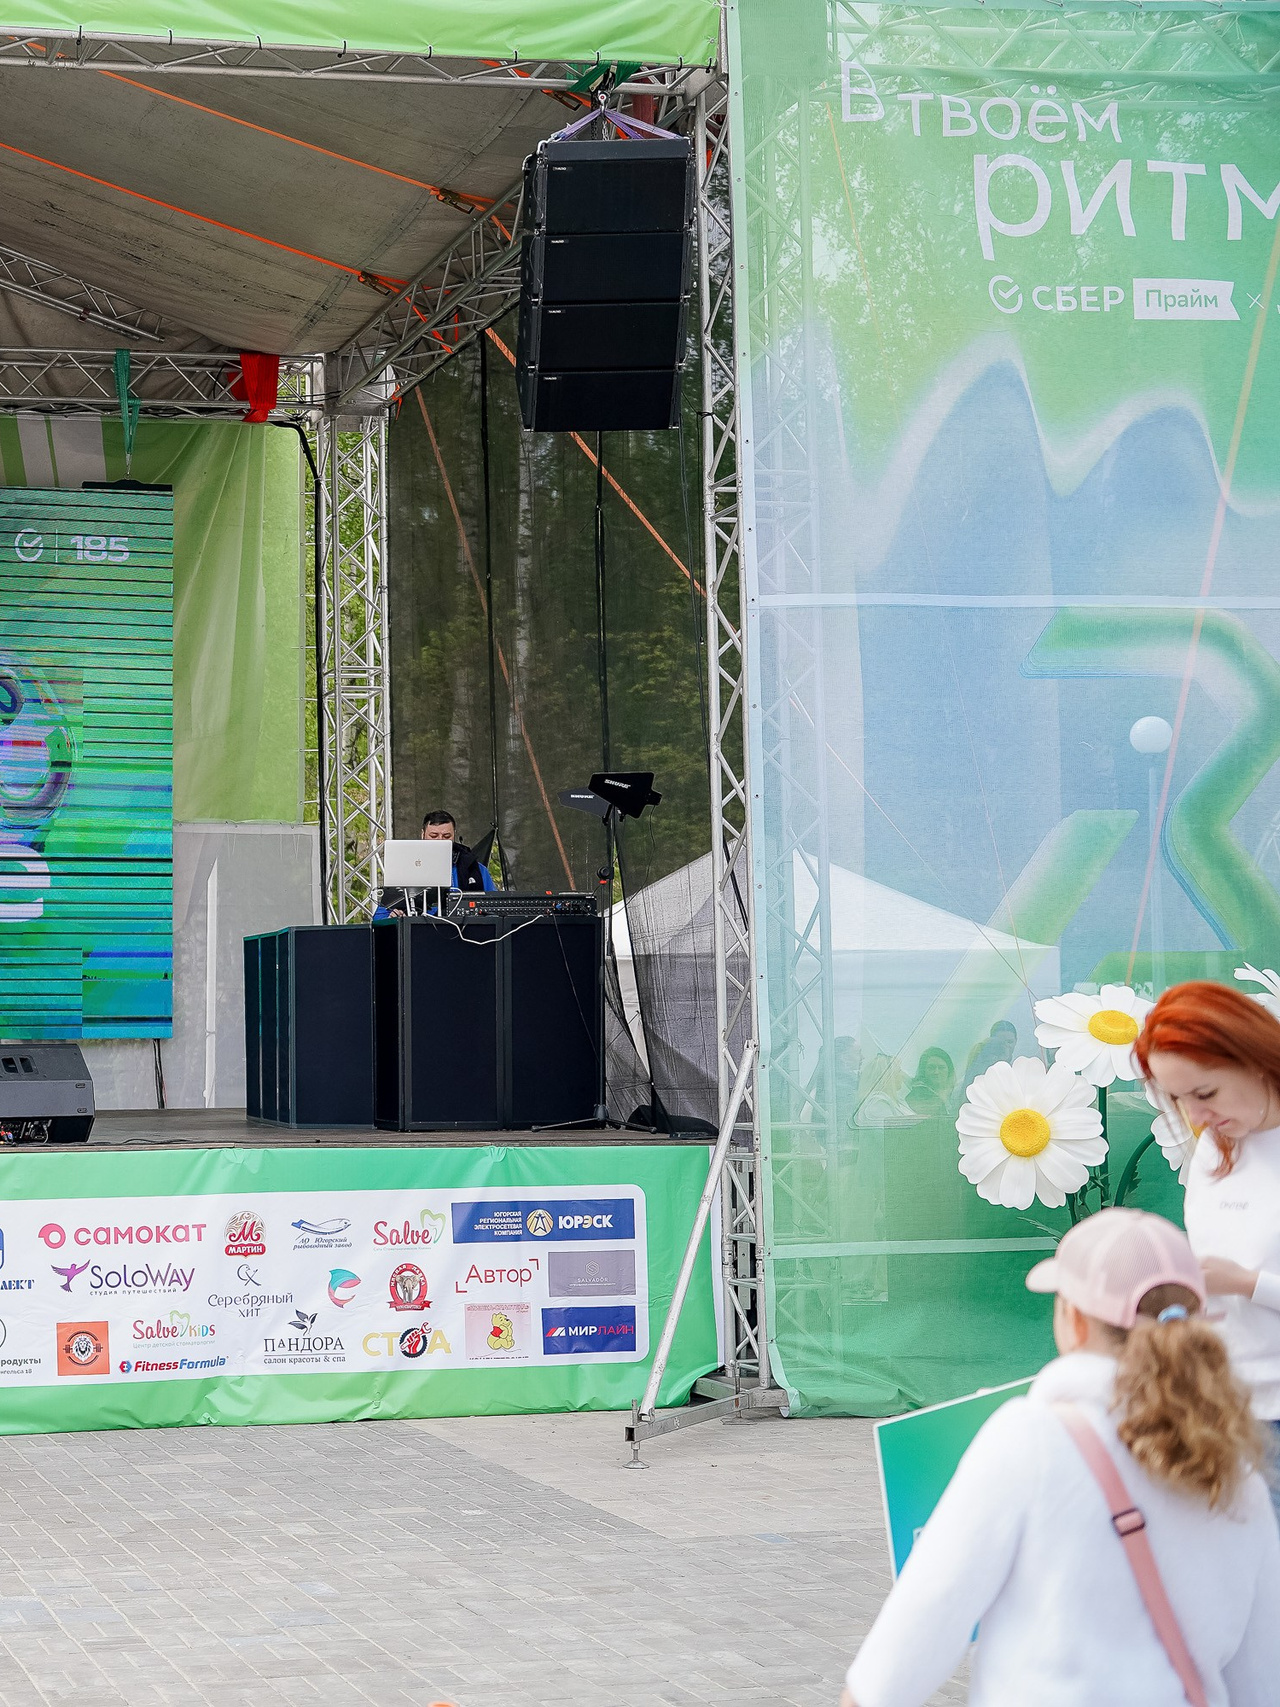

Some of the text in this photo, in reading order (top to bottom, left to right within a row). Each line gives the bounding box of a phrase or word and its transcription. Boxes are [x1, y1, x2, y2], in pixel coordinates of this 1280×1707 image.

[841, 62, 1123, 143] В твоём
[1032, 285, 1219, 313] СБЕР Прайм
[70, 535, 130, 562] 185
[558, 1214, 614, 1229] ЮРЭСК
[73, 1224, 207, 1246] самокат
[373, 1220, 433, 1246] Salve
[228, 1245, 263, 1254] МАРТИН
[465, 1264, 532, 1287] Автор
[208, 1292, 293, 1308] Серебряный
[132, 1320, 180, 1340] Salve
[569, 1324, 634, 1337] МИРЛАЙН
[264, 1336, 345, 1353] ПАНДОРА
[134, 1355, 226, 1373] FitnessFormula
[288, 1355, 321, 1365] красоты
